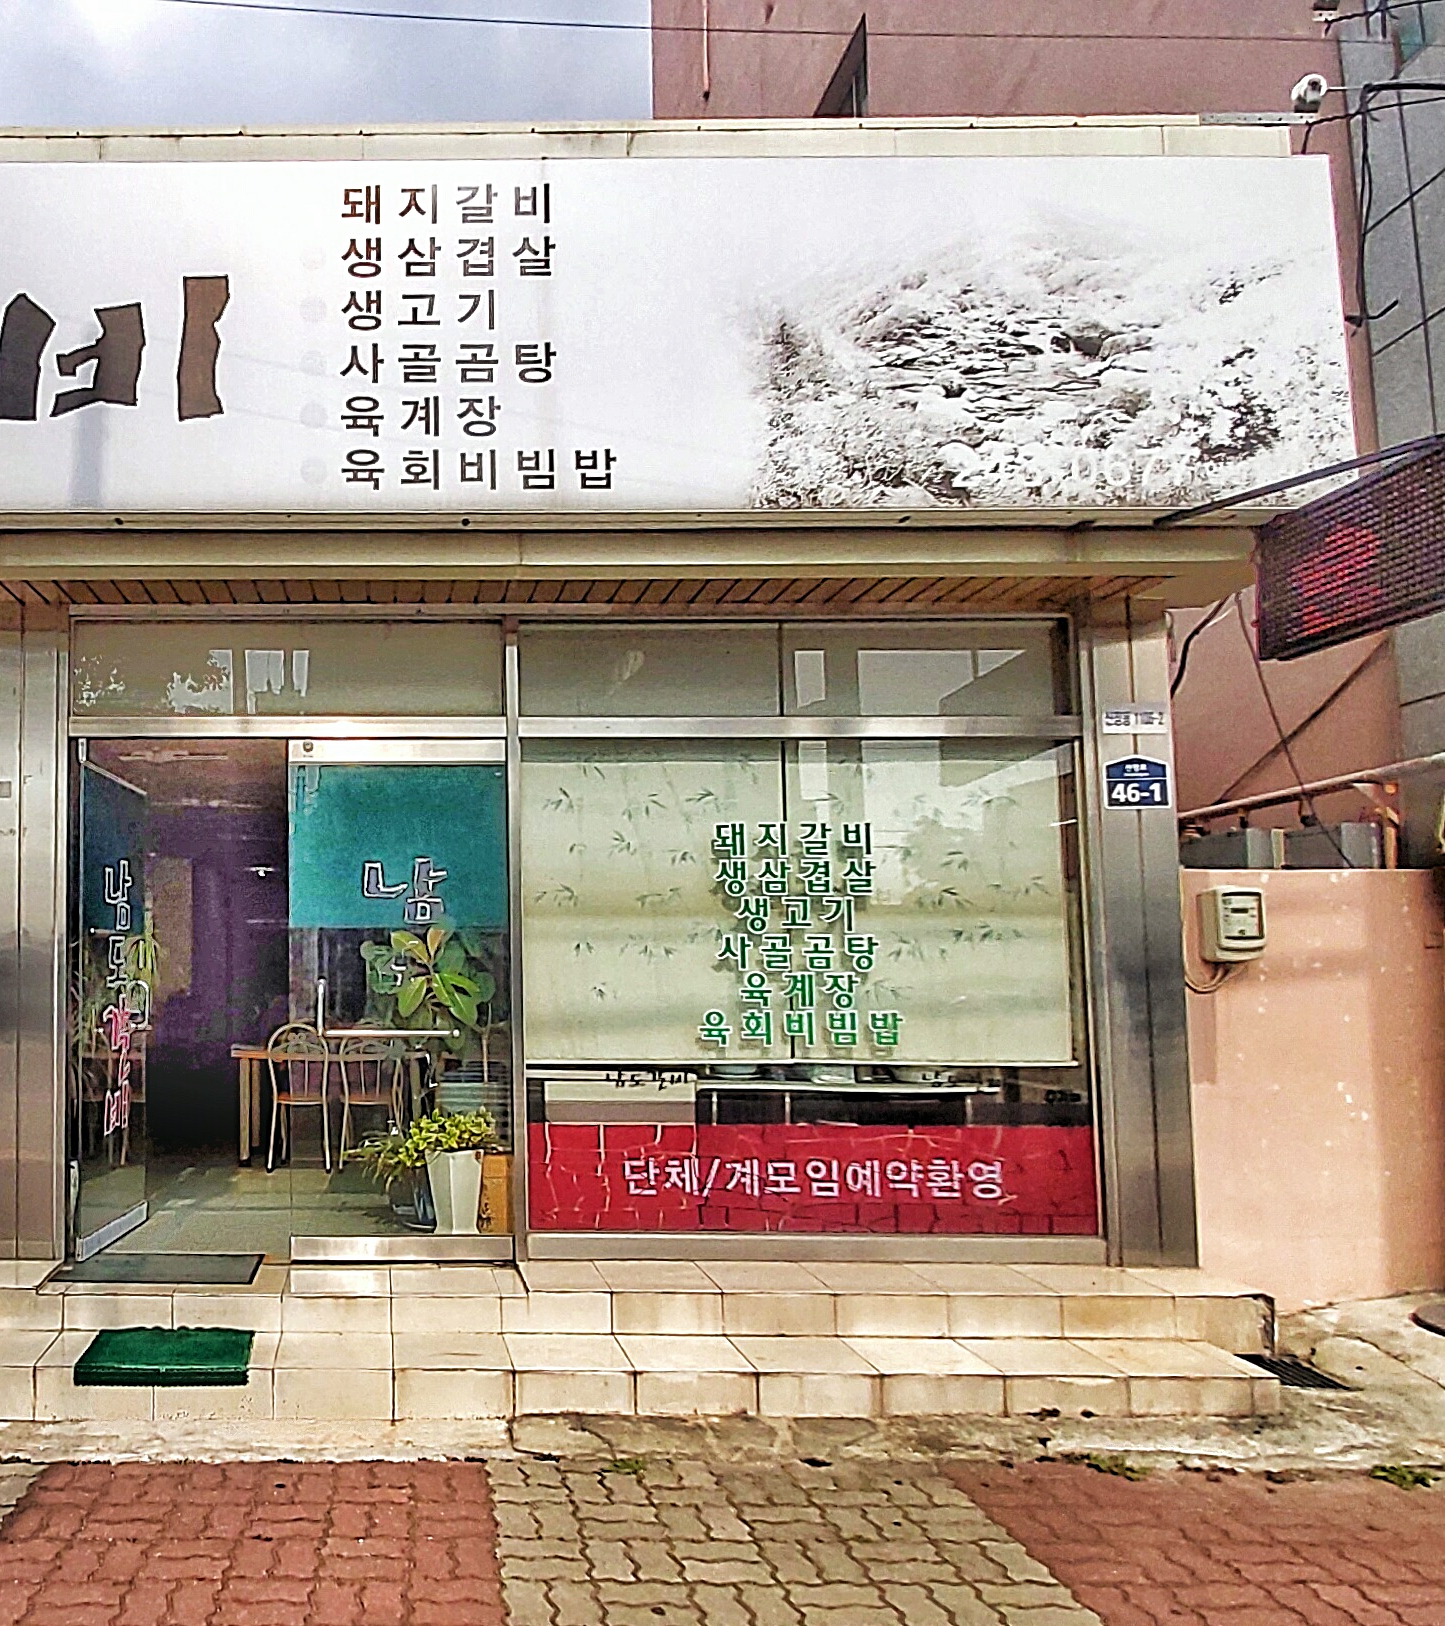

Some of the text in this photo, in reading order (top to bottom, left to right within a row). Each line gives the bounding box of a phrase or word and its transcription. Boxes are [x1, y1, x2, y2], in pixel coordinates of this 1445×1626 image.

[341, 183, 551, 225] 돼지갈비
[341, 236, 557, 278] 생삼겹살
[341, 289, 495, 331] 생고기
[339, 341, 557, 384] 사골곰탕
[340, 395, 502, 437] 육계장
[340, 448, 617, 491] 육회비빔밥
[1111, 782, 1161, 803] 46-1
[714, 822, 875, 857] 돼지갈비
[715, 859, 877, 895] 생삼겹살
[737, 897, 855, 934] 생고기
[717, 934, 880, 972] 사골곰탕
[740, 972, 858, 1010] 육계장
[698, 1010, 904, 1047] 육회비빔밥
[623, 1156, 1005, 1200] 단체/계모임예약환영
